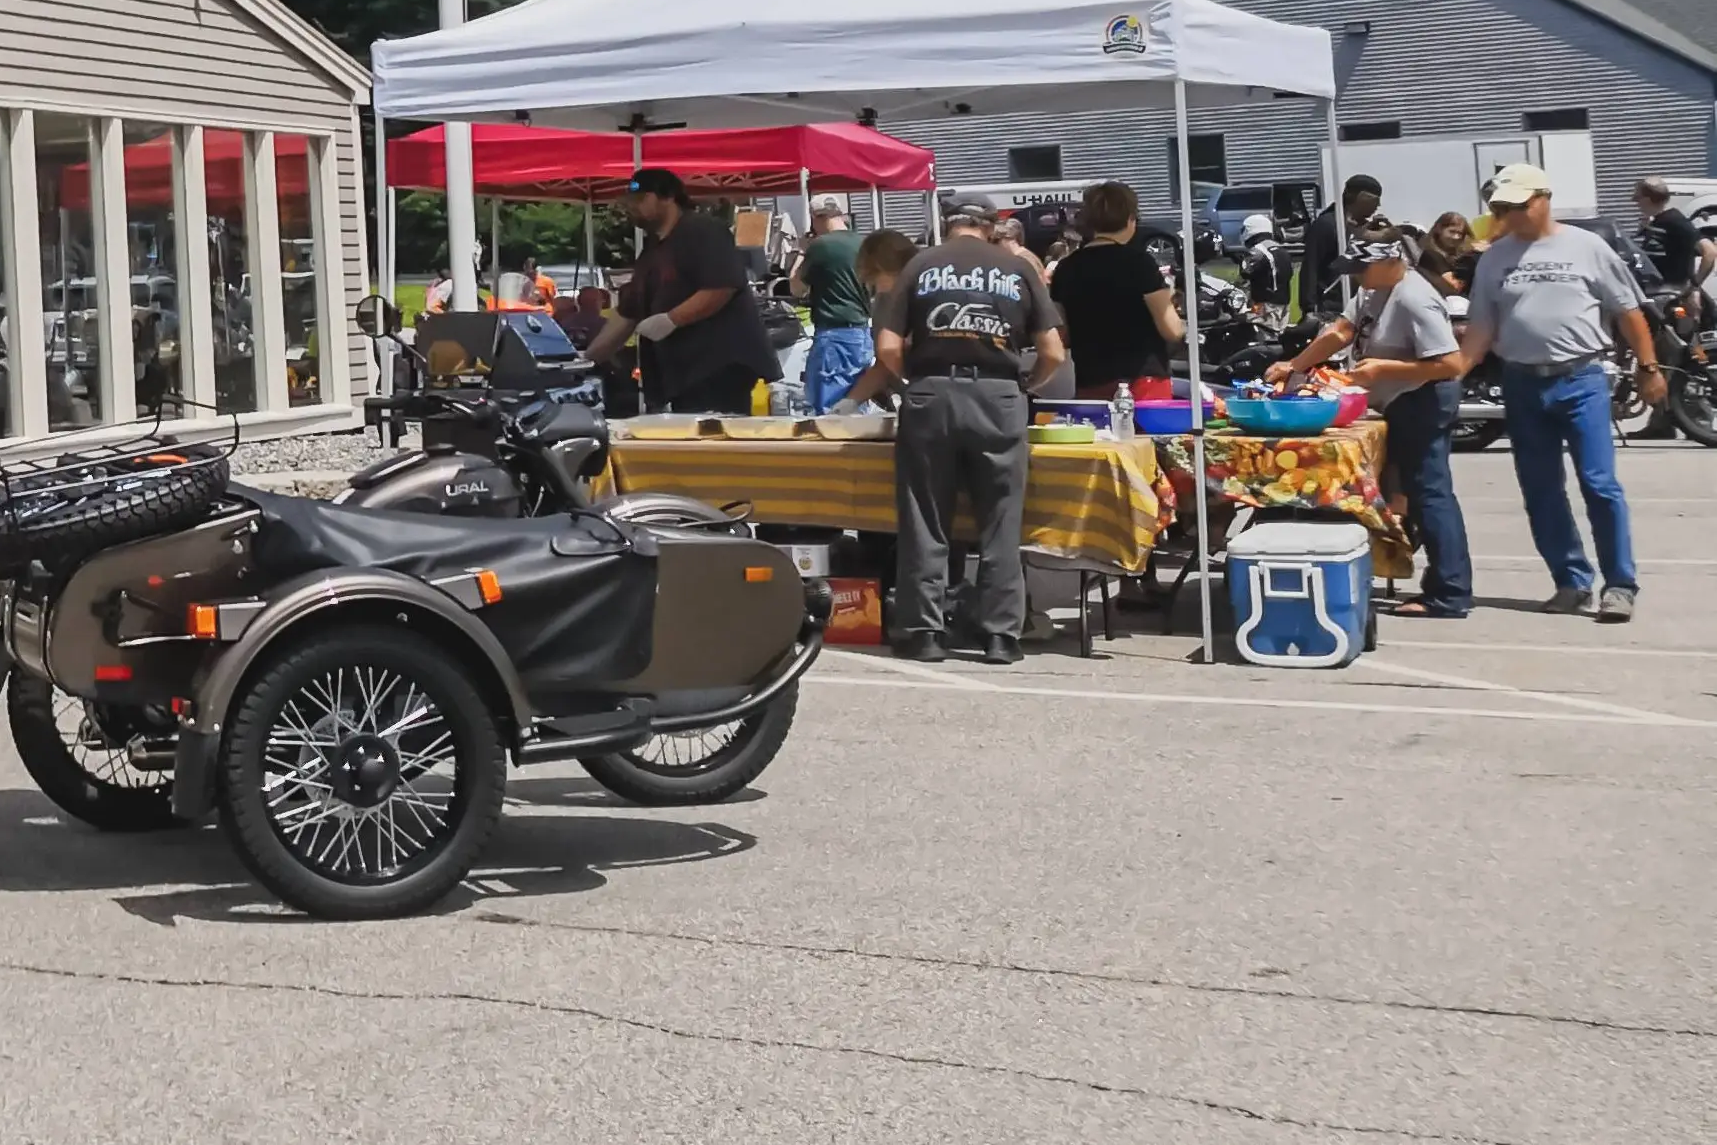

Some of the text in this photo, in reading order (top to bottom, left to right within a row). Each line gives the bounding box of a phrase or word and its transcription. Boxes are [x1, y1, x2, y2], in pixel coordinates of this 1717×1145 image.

[1012, 193, 1073, 206] U-HAUL
[1503, 261, 1574, 277] NOCENT
[916, 264, 985, 295] Black
[926, 302, 1012, 337] Classic
[445, 480, 489, 497] URAL
